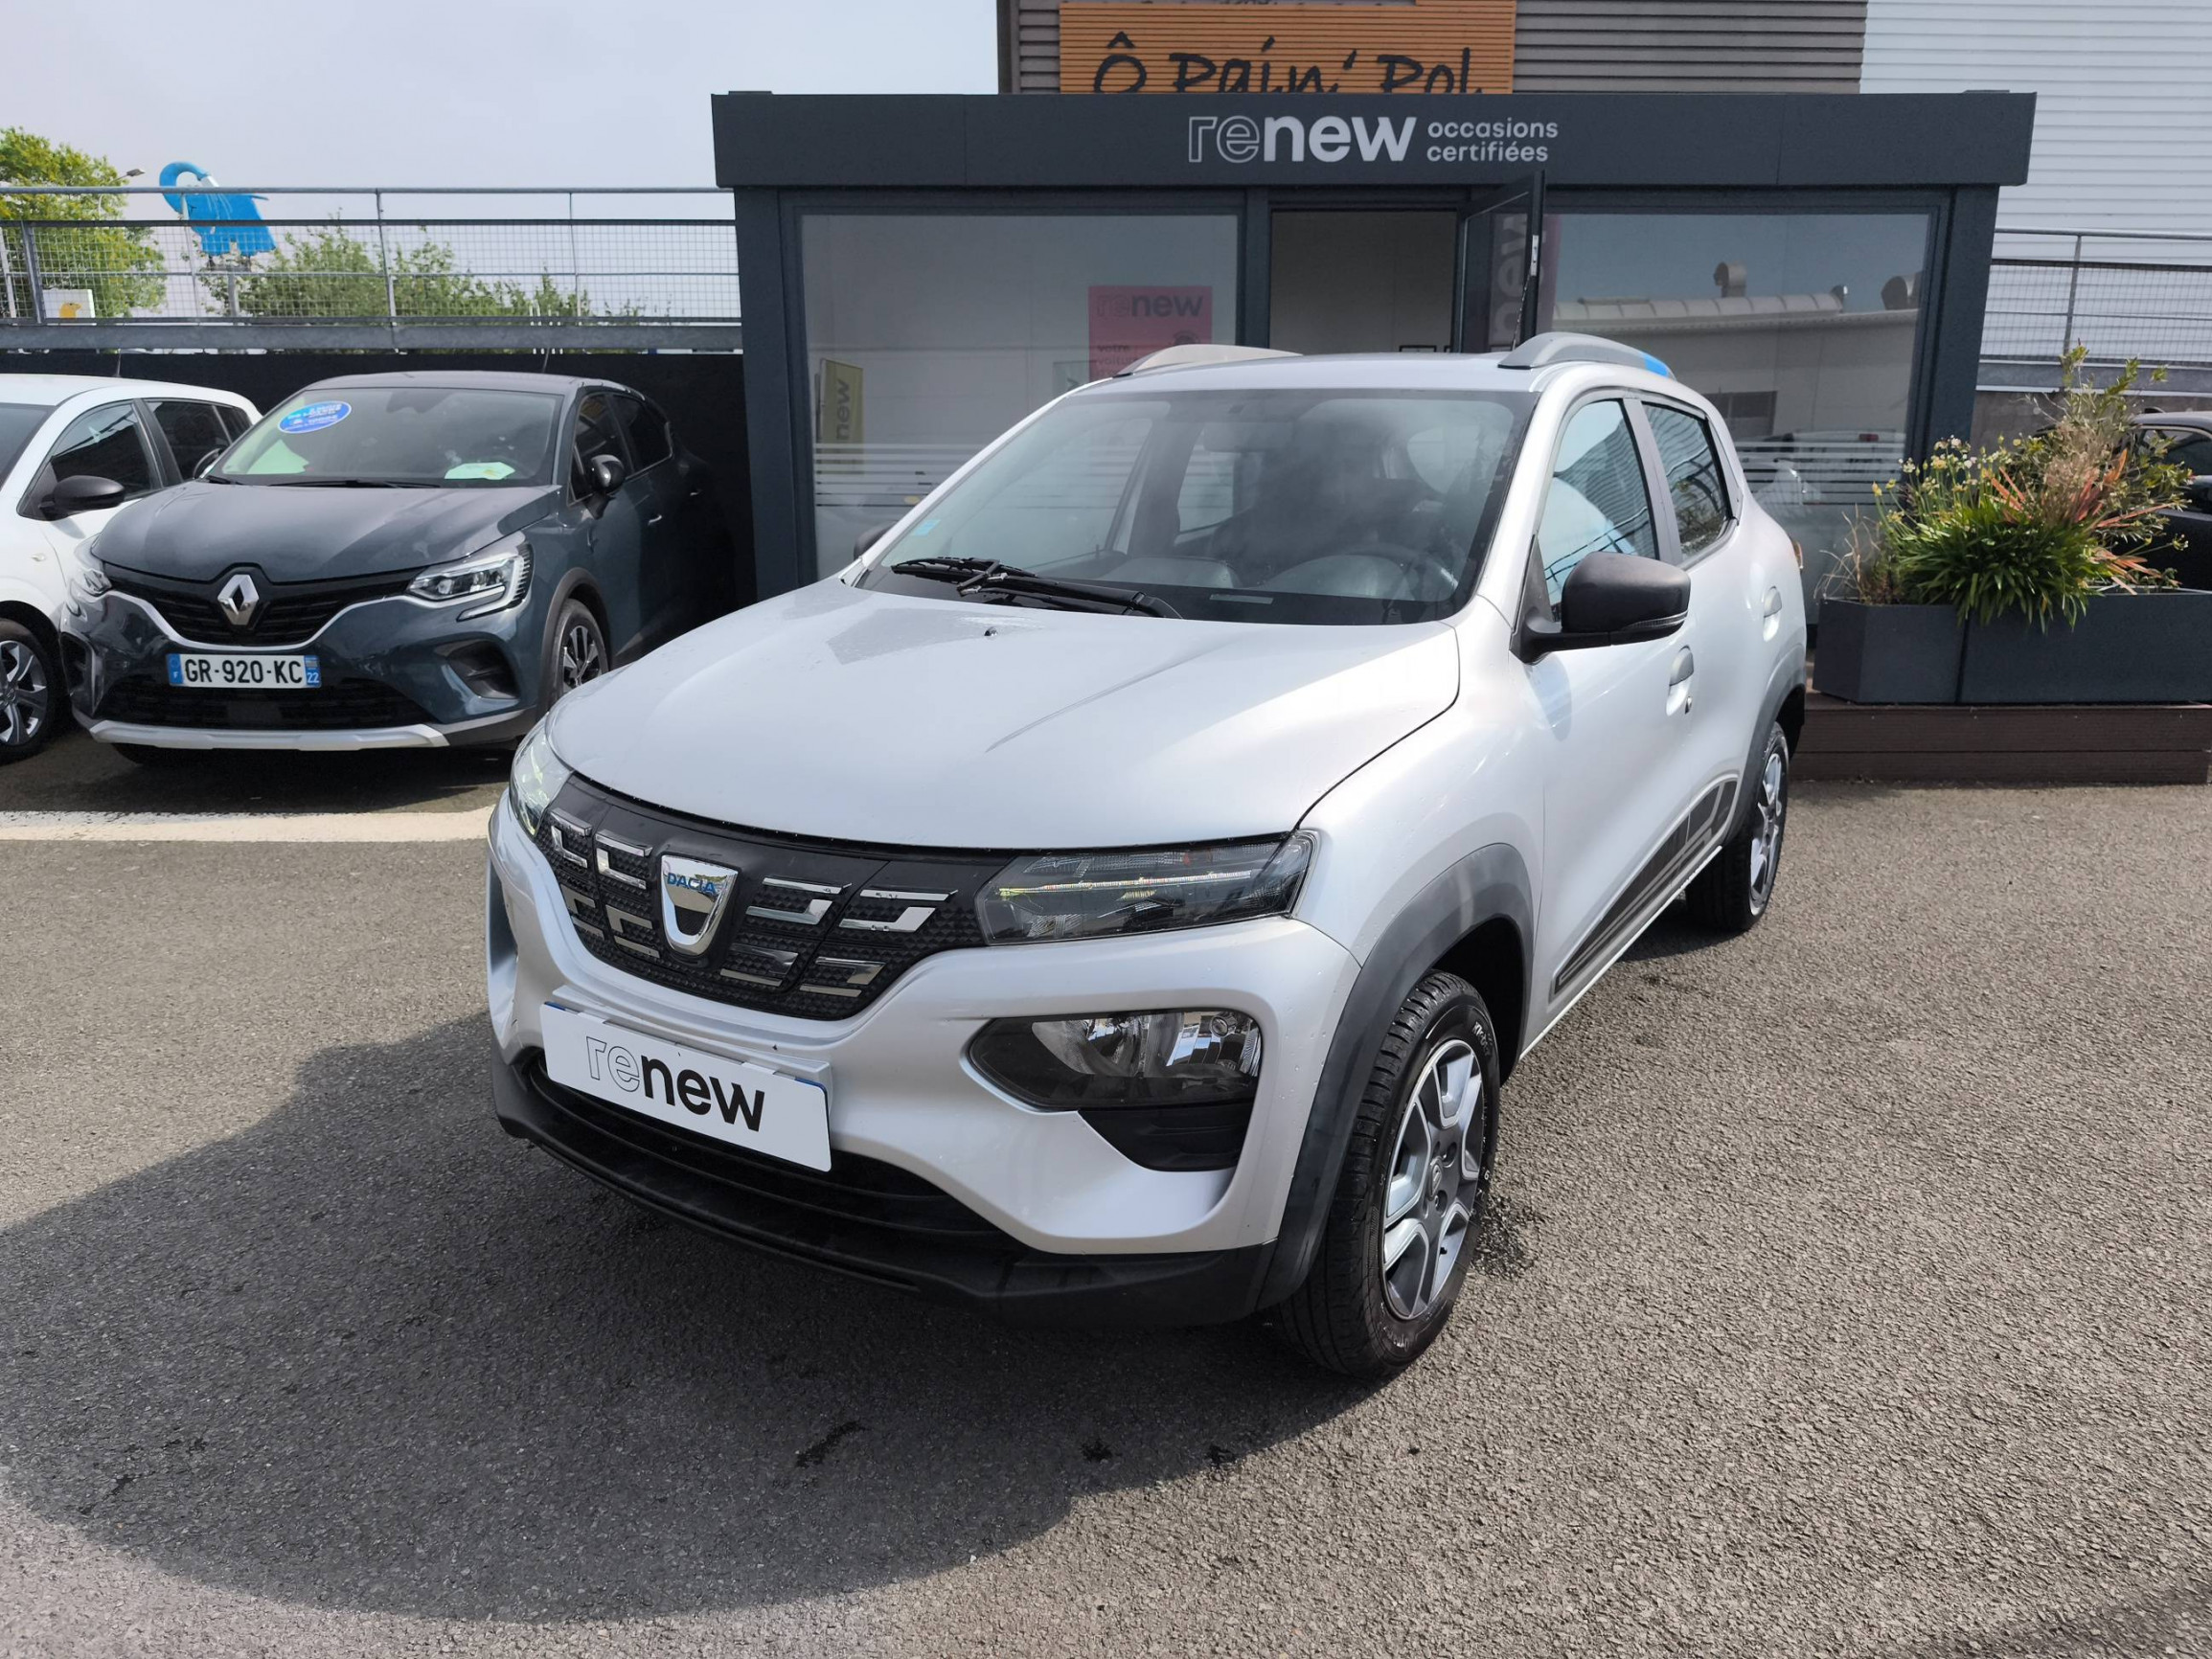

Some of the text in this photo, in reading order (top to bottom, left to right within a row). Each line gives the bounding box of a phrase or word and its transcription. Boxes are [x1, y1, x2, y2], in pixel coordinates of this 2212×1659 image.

[1093, 32, 1147, 93] Ô
[1188, 115, 1559, 163] renew occasions
[1426, 140, 1548, 163] certifiées
[1096, 294, 1204, 318] renew
[184, 659, 303, 684] GR-920-KC
[306, 671, 320, 684] 22
[667, 872, 717, 896] DACIA
[585, 1035, 765, 1132] renew
